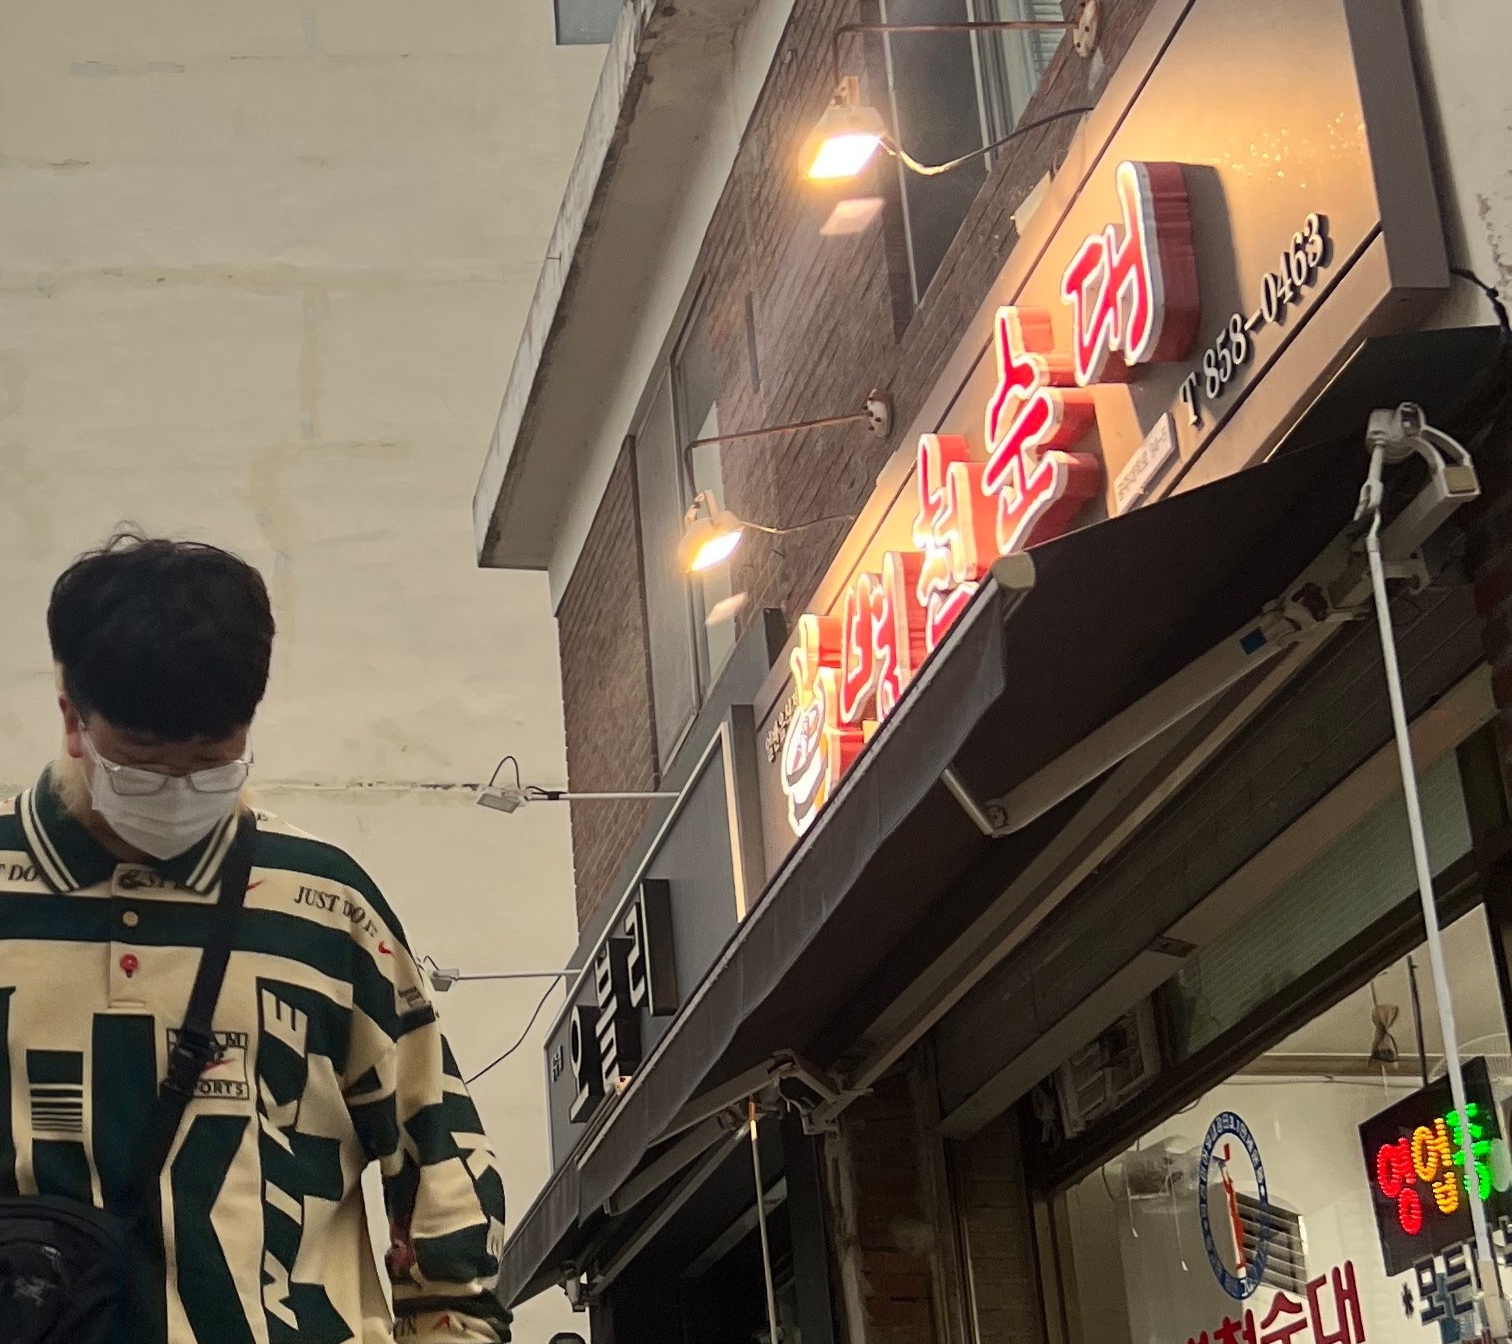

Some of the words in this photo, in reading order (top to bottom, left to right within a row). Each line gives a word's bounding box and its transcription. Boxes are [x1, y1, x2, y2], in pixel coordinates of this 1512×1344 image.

[1203, 211, 1332, 401] 858-0463
[293, 885, 339, 914] JUST
[198, 1081, 245, 1096] ORTS
[1376, 1102, 1493, 1236] 영업중
